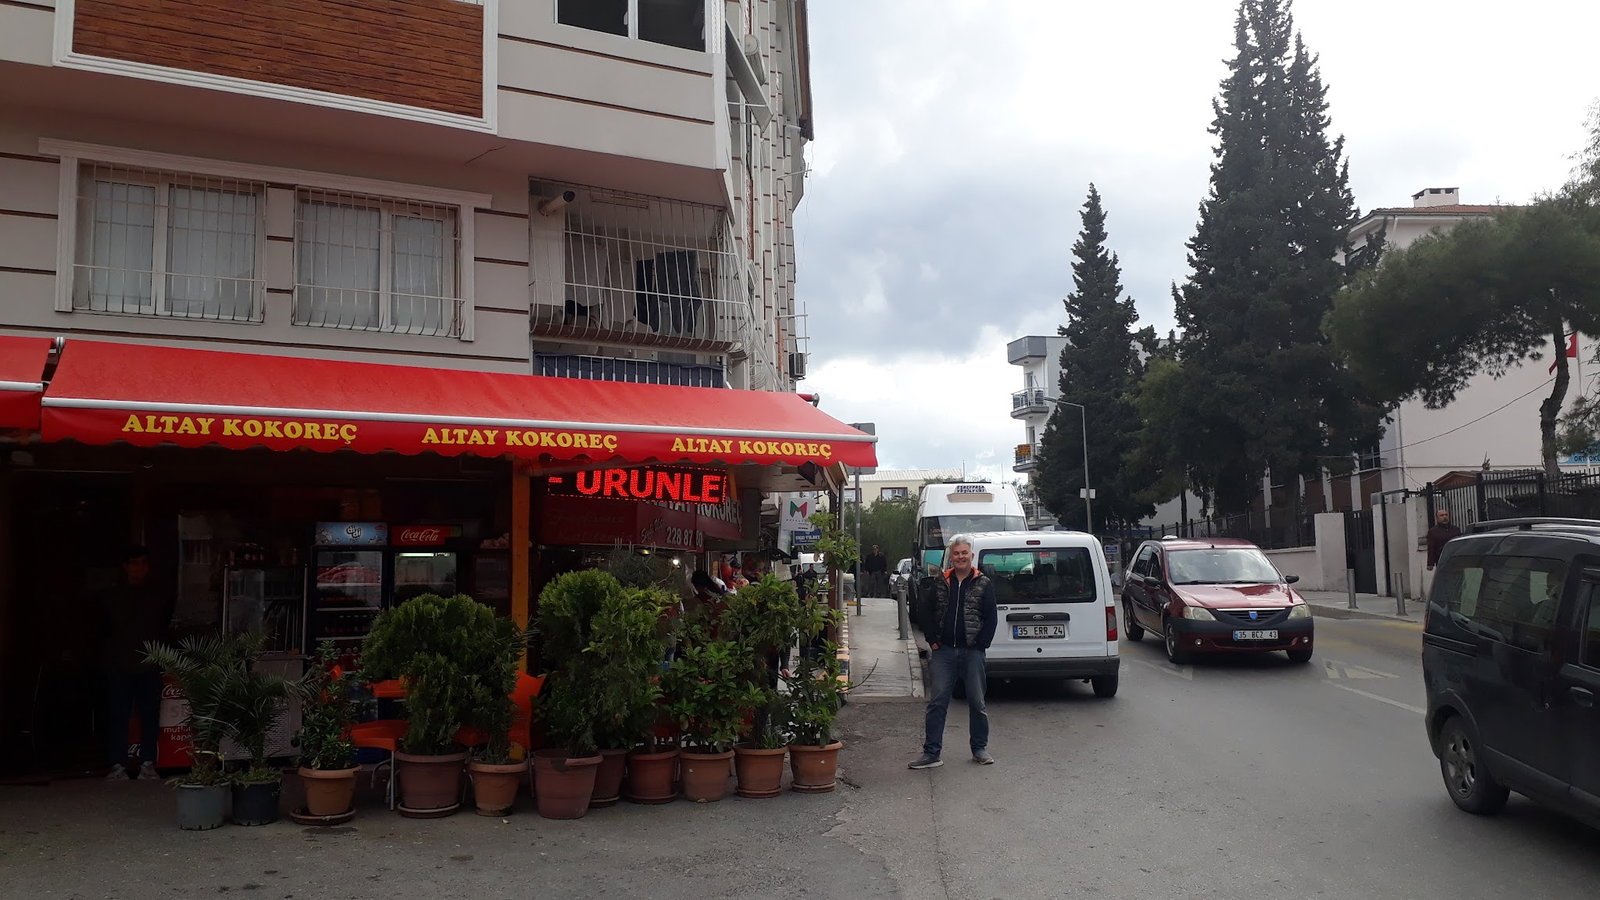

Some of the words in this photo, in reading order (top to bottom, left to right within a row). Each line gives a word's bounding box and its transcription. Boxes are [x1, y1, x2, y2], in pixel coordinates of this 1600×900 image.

[122, 414, 215, 435] ALTAY
[222, 418, 357, 445] KOKOREÇ
[421, 427, 499, 446] ALTAY
[505, 430, 618, 453] KOKOREÇ
[671, 437, 733, 454] ALTAY
[738, 440, 832, 460] KOKOREÇ
[666, 526, 682, 546] 228
[683, 529, 693, 547] 87
[1018, 627, 1028, 636] 35
[1034, 626, 1049, 636] ERR
[1053, 626, 1063, 635] 24
[1238, 631, 1247, 639] 35
